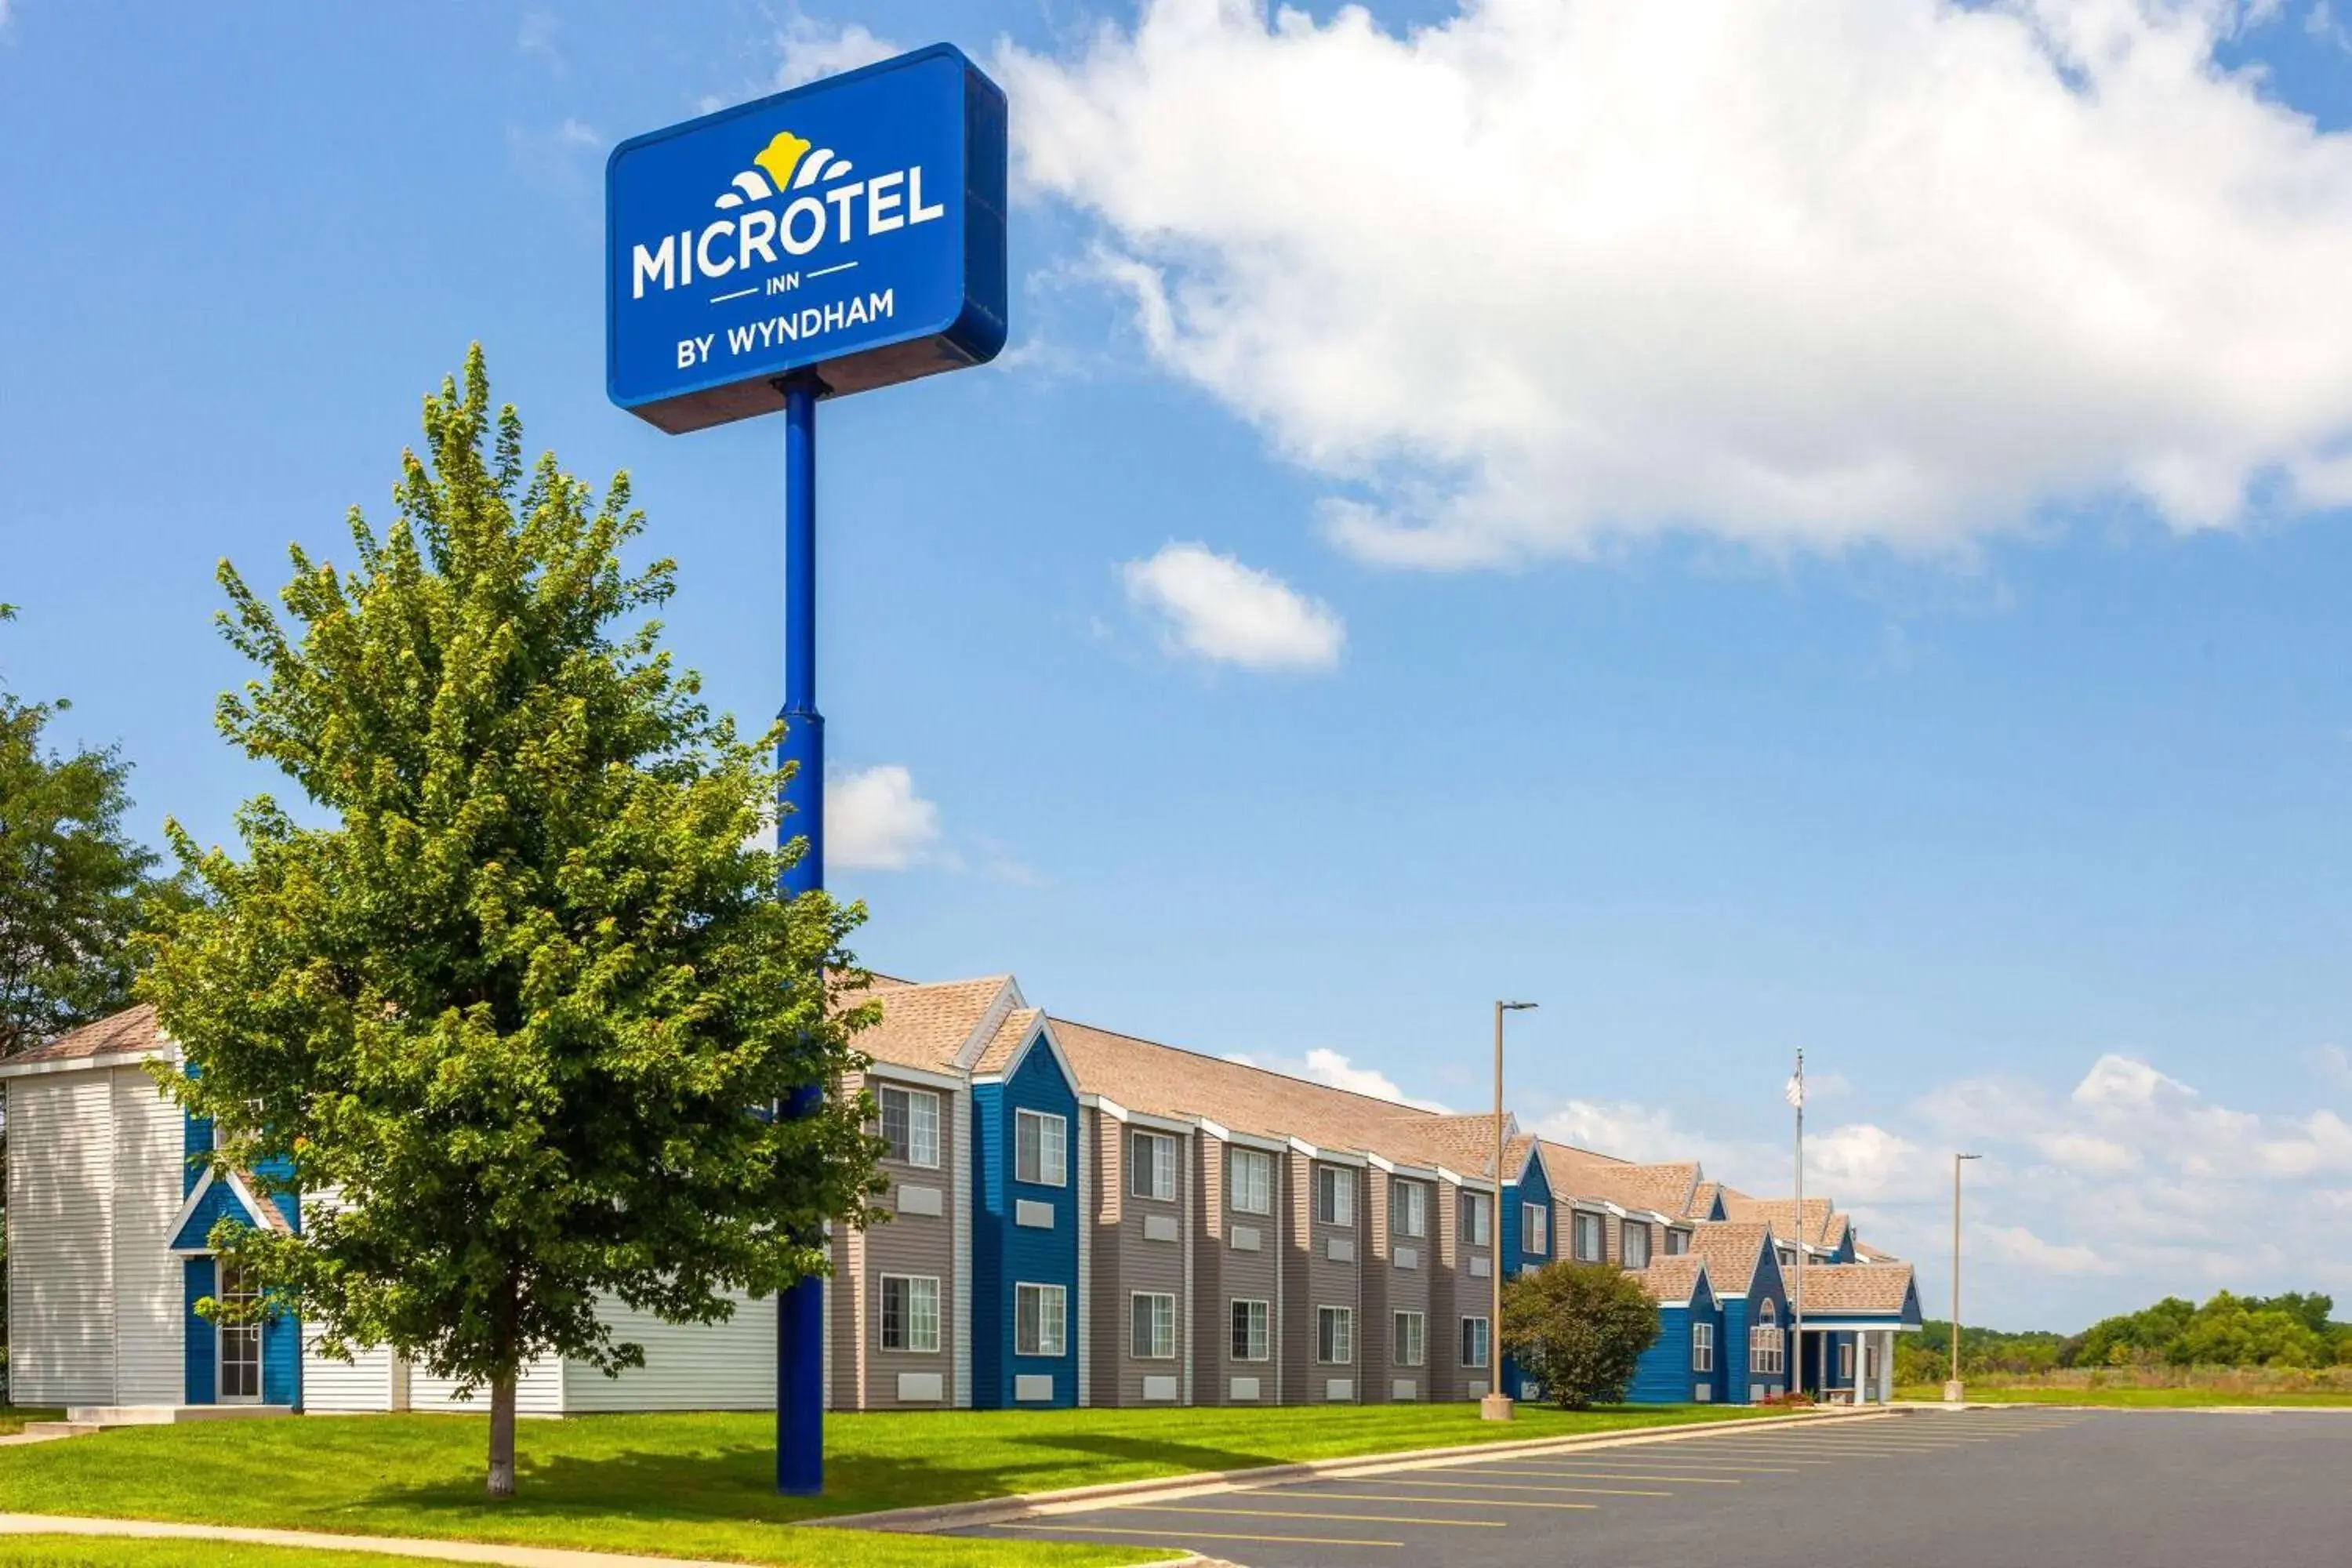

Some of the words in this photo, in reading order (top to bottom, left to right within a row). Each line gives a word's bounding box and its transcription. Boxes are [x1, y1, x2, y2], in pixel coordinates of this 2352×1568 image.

[632, 165, 945, 299] MICROTEL
[765, 271, 800, 296] INN
[677, 332, 715, 369] BY
[727, 289, 894, 356] WYNDHAM
